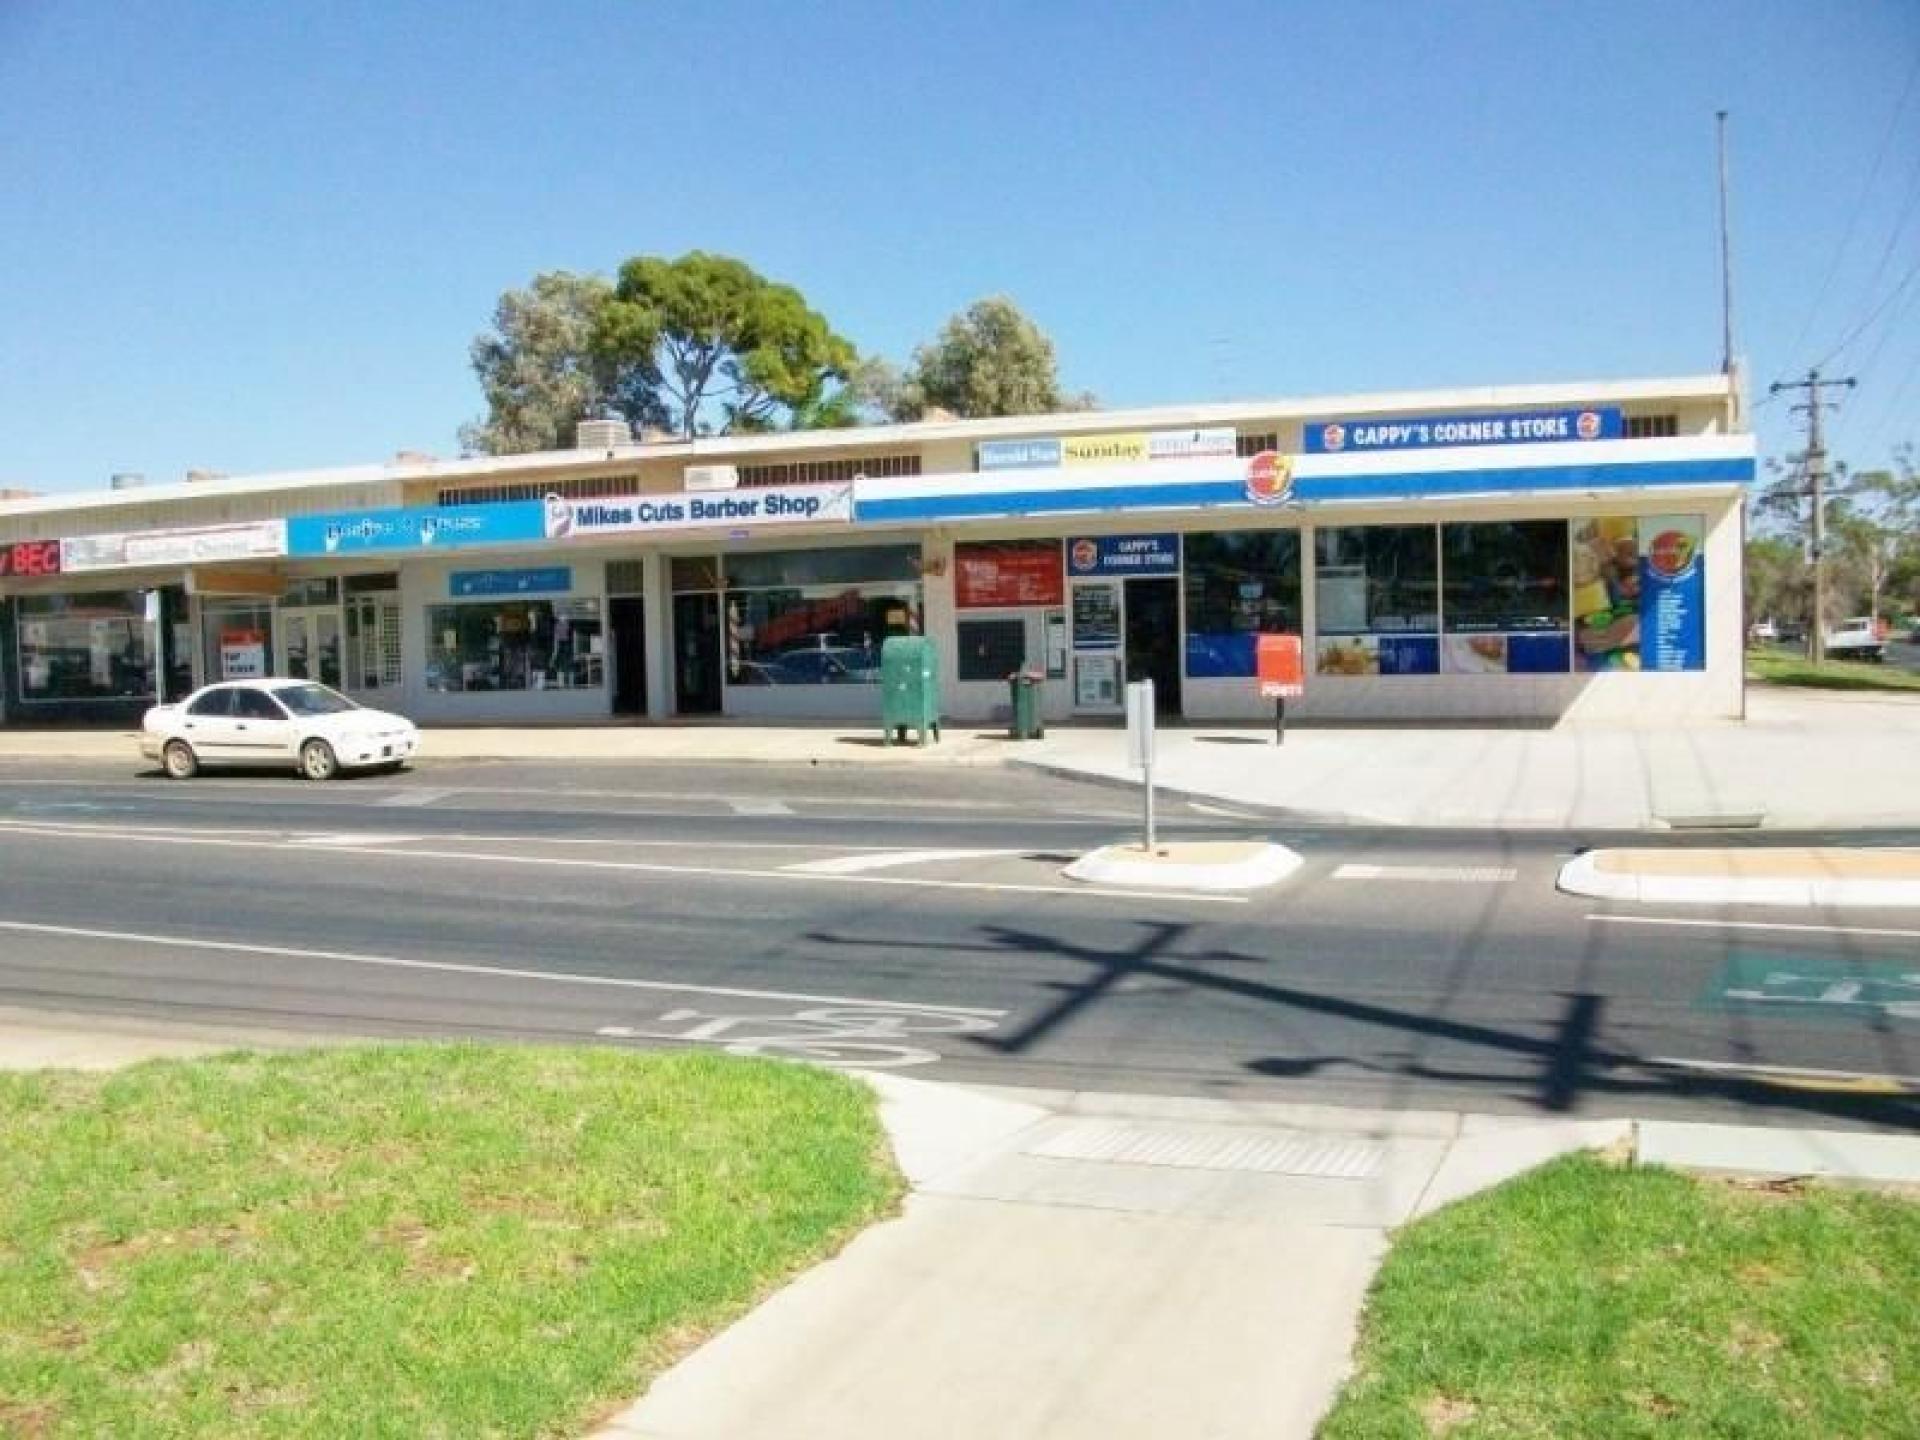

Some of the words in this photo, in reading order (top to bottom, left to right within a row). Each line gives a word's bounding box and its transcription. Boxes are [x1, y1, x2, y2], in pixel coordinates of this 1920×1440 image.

[1434, 420, 1506, 443] CORNER
[1511, 416, 1569, 438] STORE
[1064, 440, 1142, 463] Sunday
[576, 506, 633, 527] Mikes
[637, 502, 685, 522] Cuts
[690, 497, 759, 519] Barber
[765, 493, 820, 517] Shop
[14, 542, 58, 577] BEC
